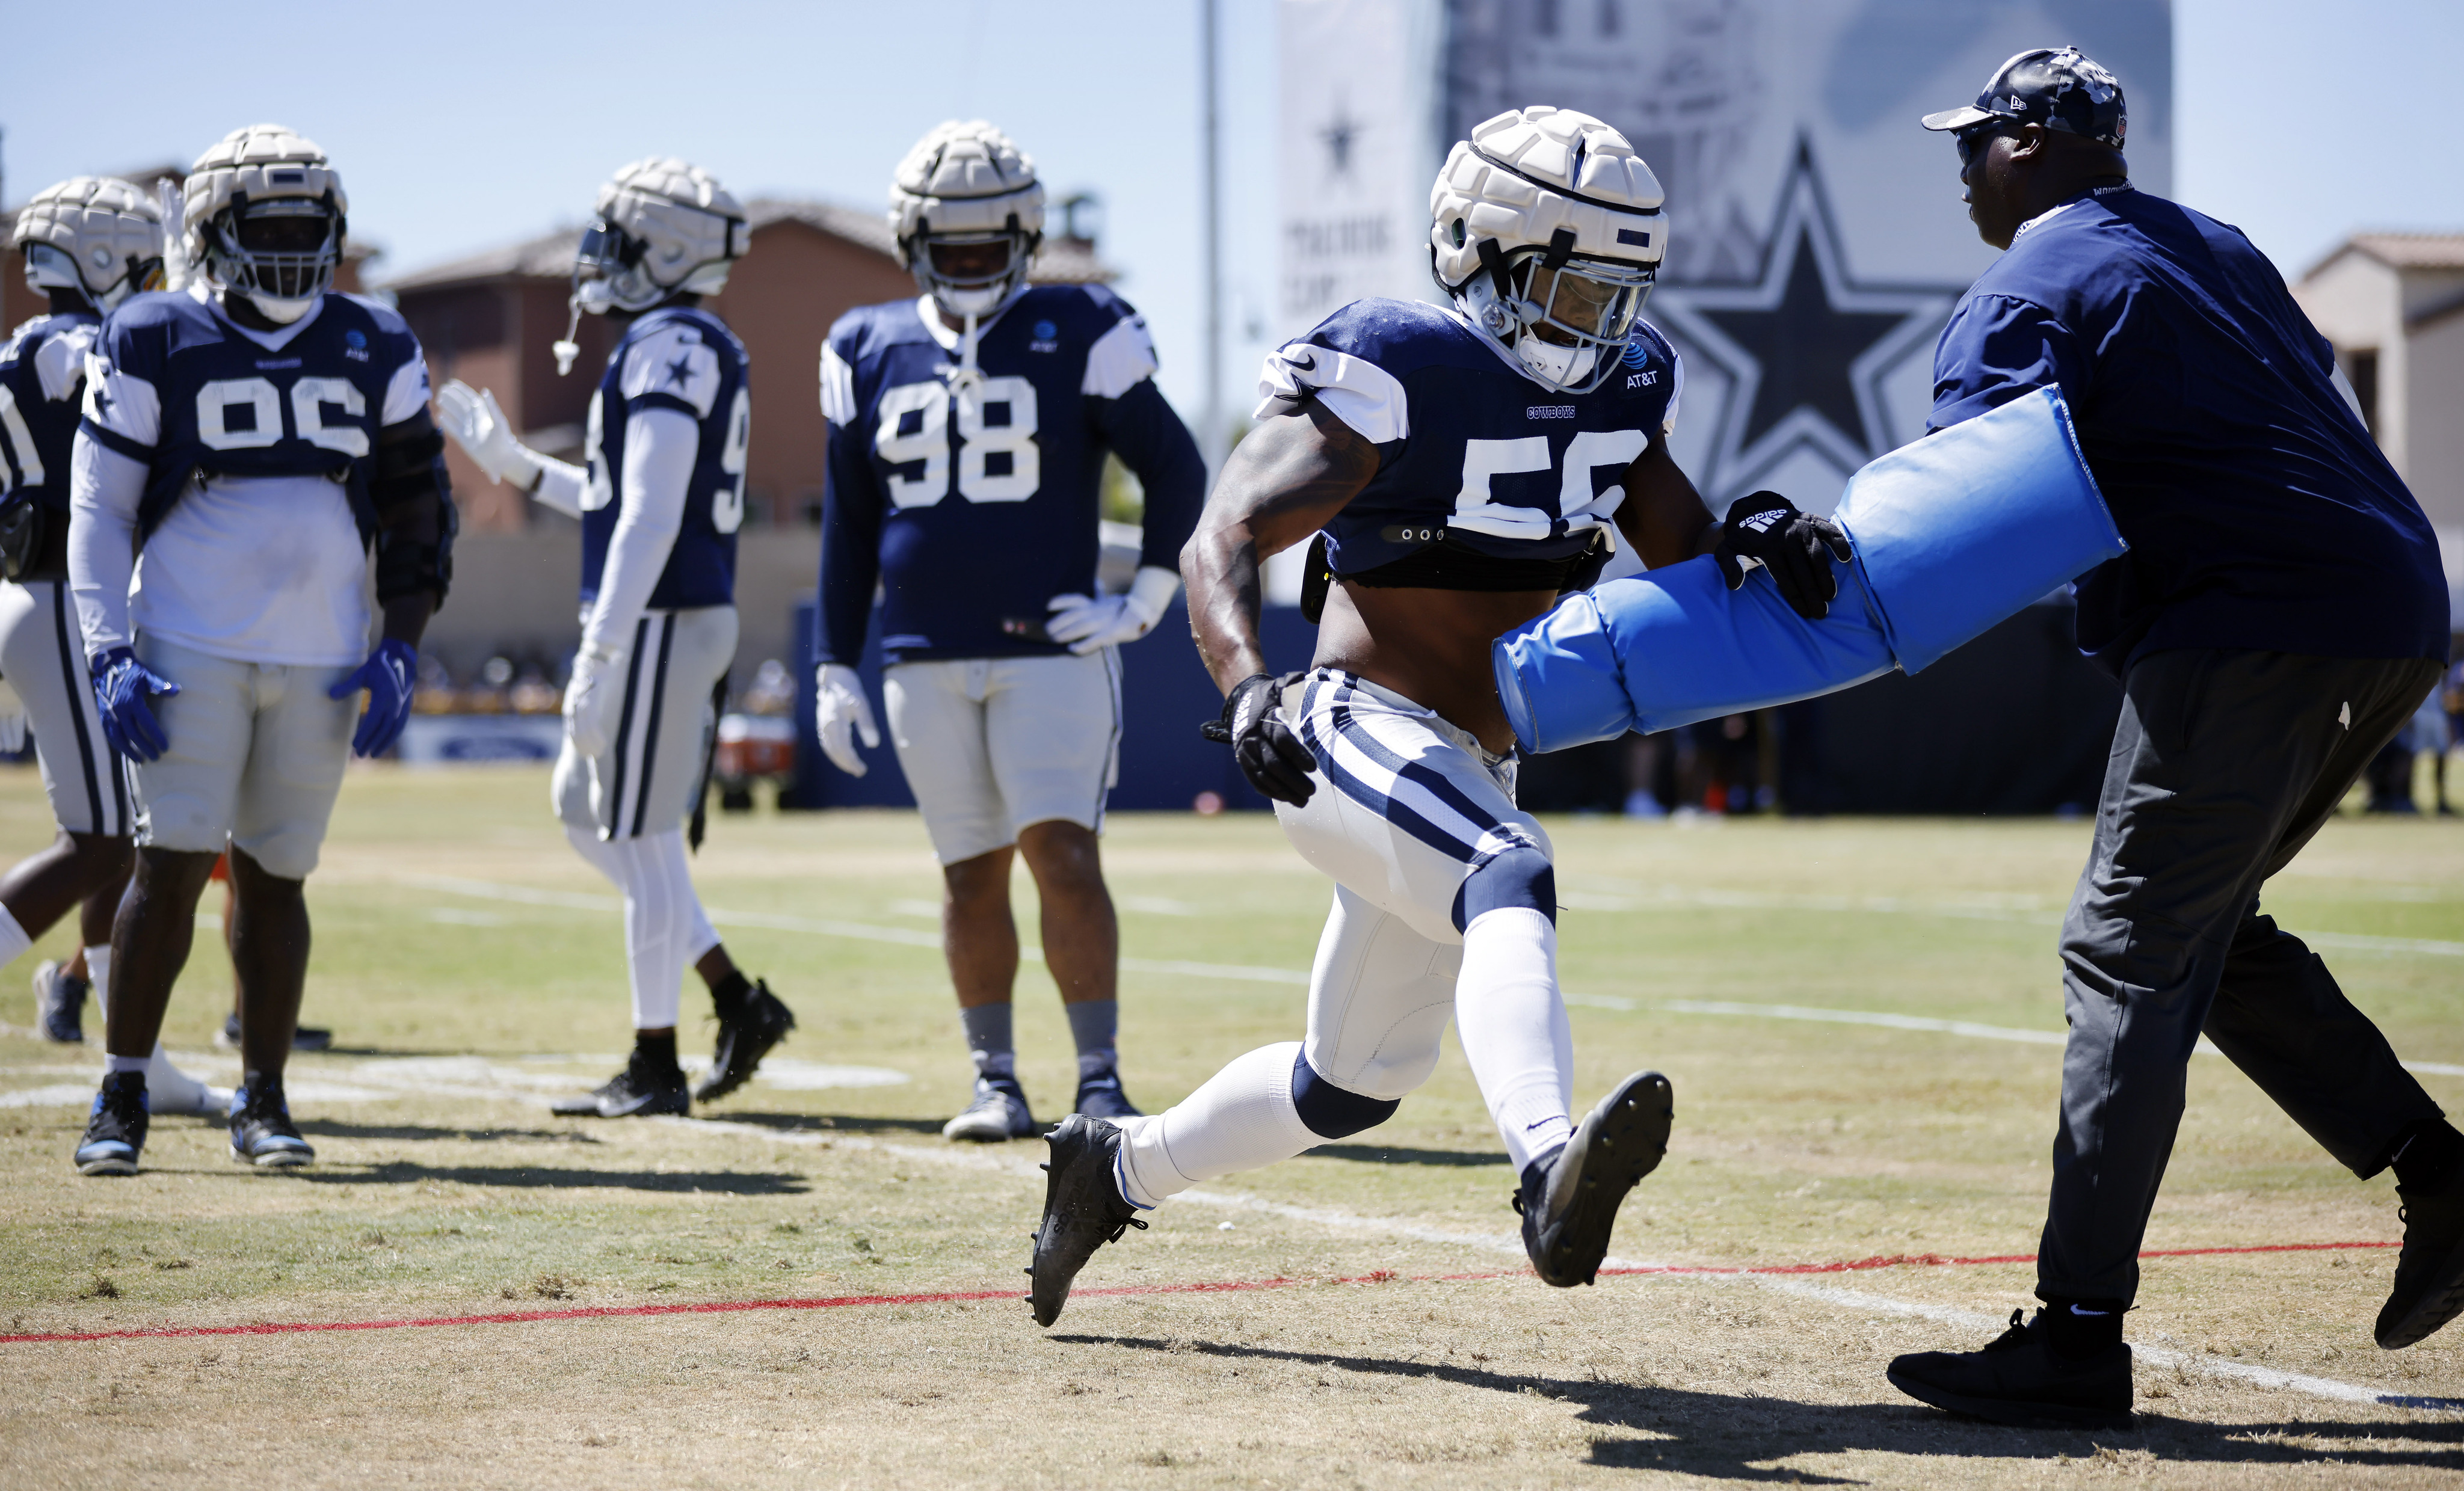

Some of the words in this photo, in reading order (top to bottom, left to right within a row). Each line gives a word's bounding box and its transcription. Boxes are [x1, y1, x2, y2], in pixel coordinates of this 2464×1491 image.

[1627, 370, 1657, 389] AT&T
[1527, 405, 1575, 420] COWBOYS
[875, 375, 1041, 509] 98
[1739, 509, 1787, 528] adidas
